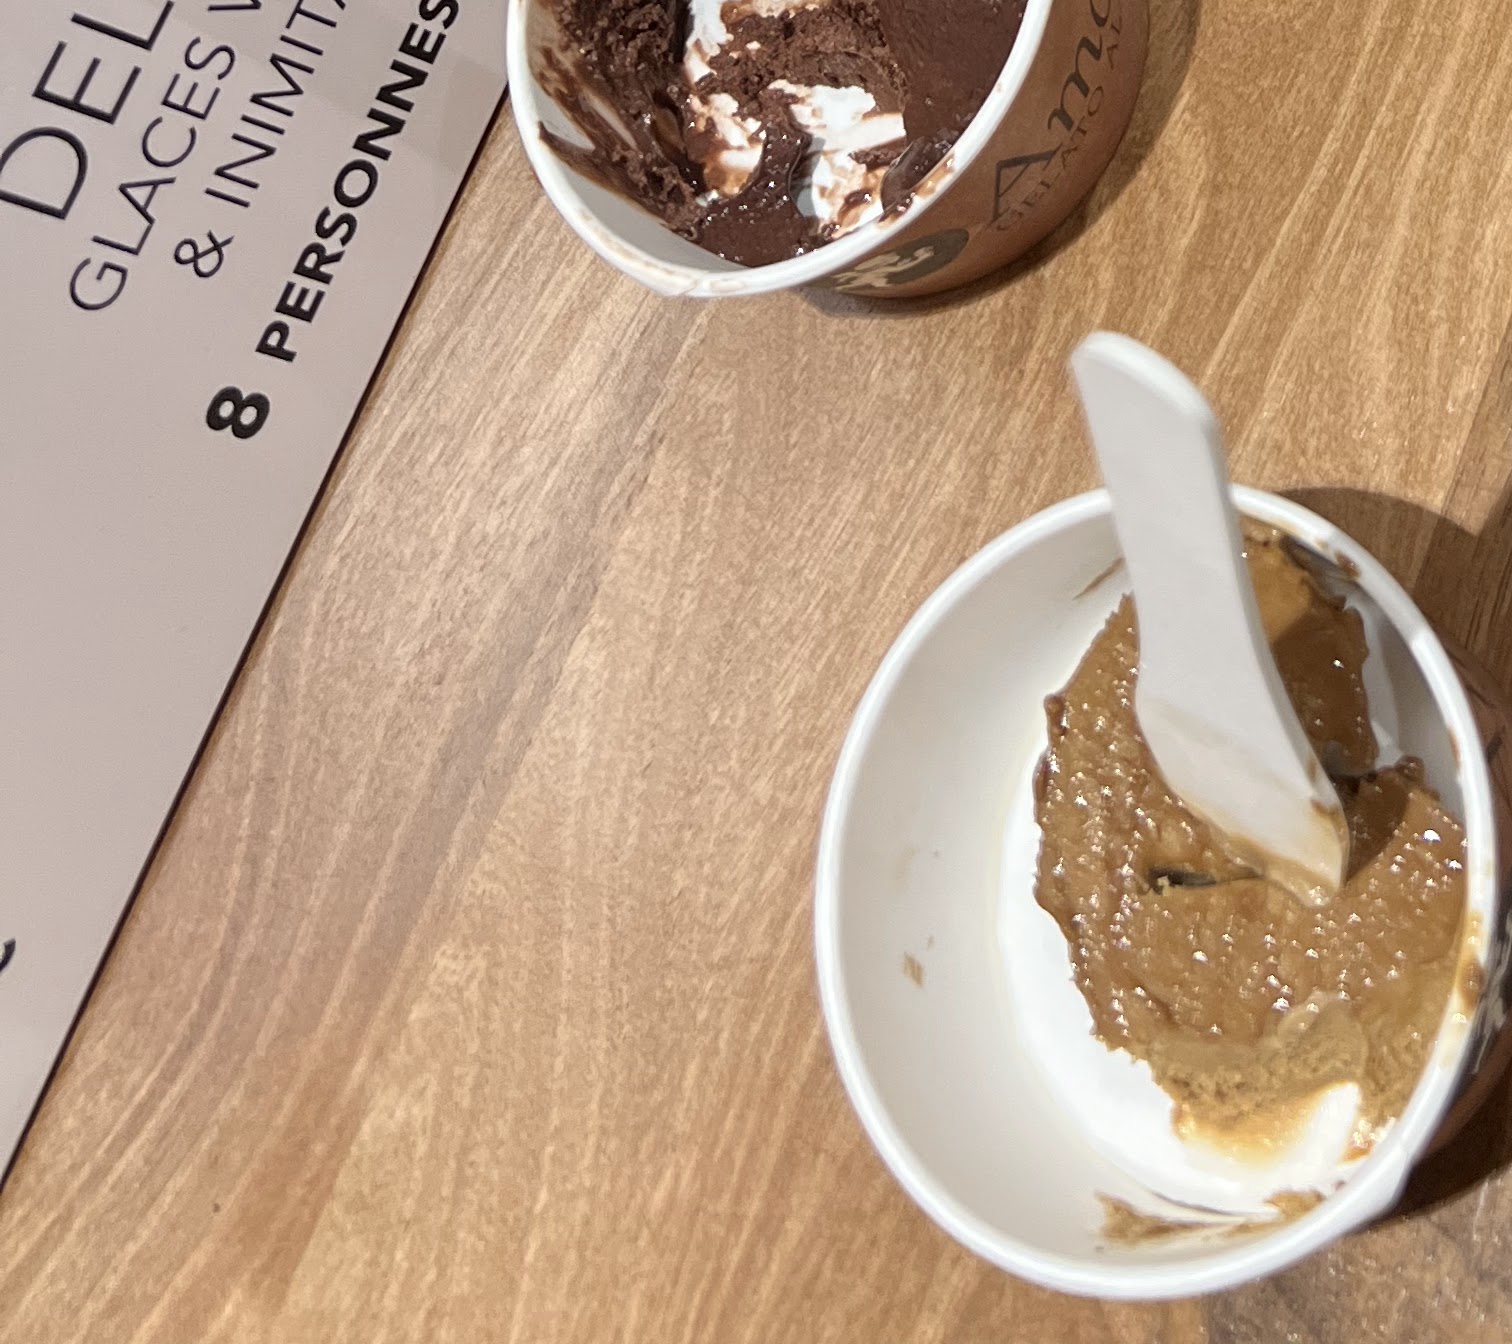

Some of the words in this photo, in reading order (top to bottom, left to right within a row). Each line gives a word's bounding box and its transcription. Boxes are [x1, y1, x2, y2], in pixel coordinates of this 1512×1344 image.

[69, 36, 236, 311] GLACES
[997, 85, 1105, 231] GELATO
[174, 229, 234, 279] &
[205, 386, 270, 440] 8
